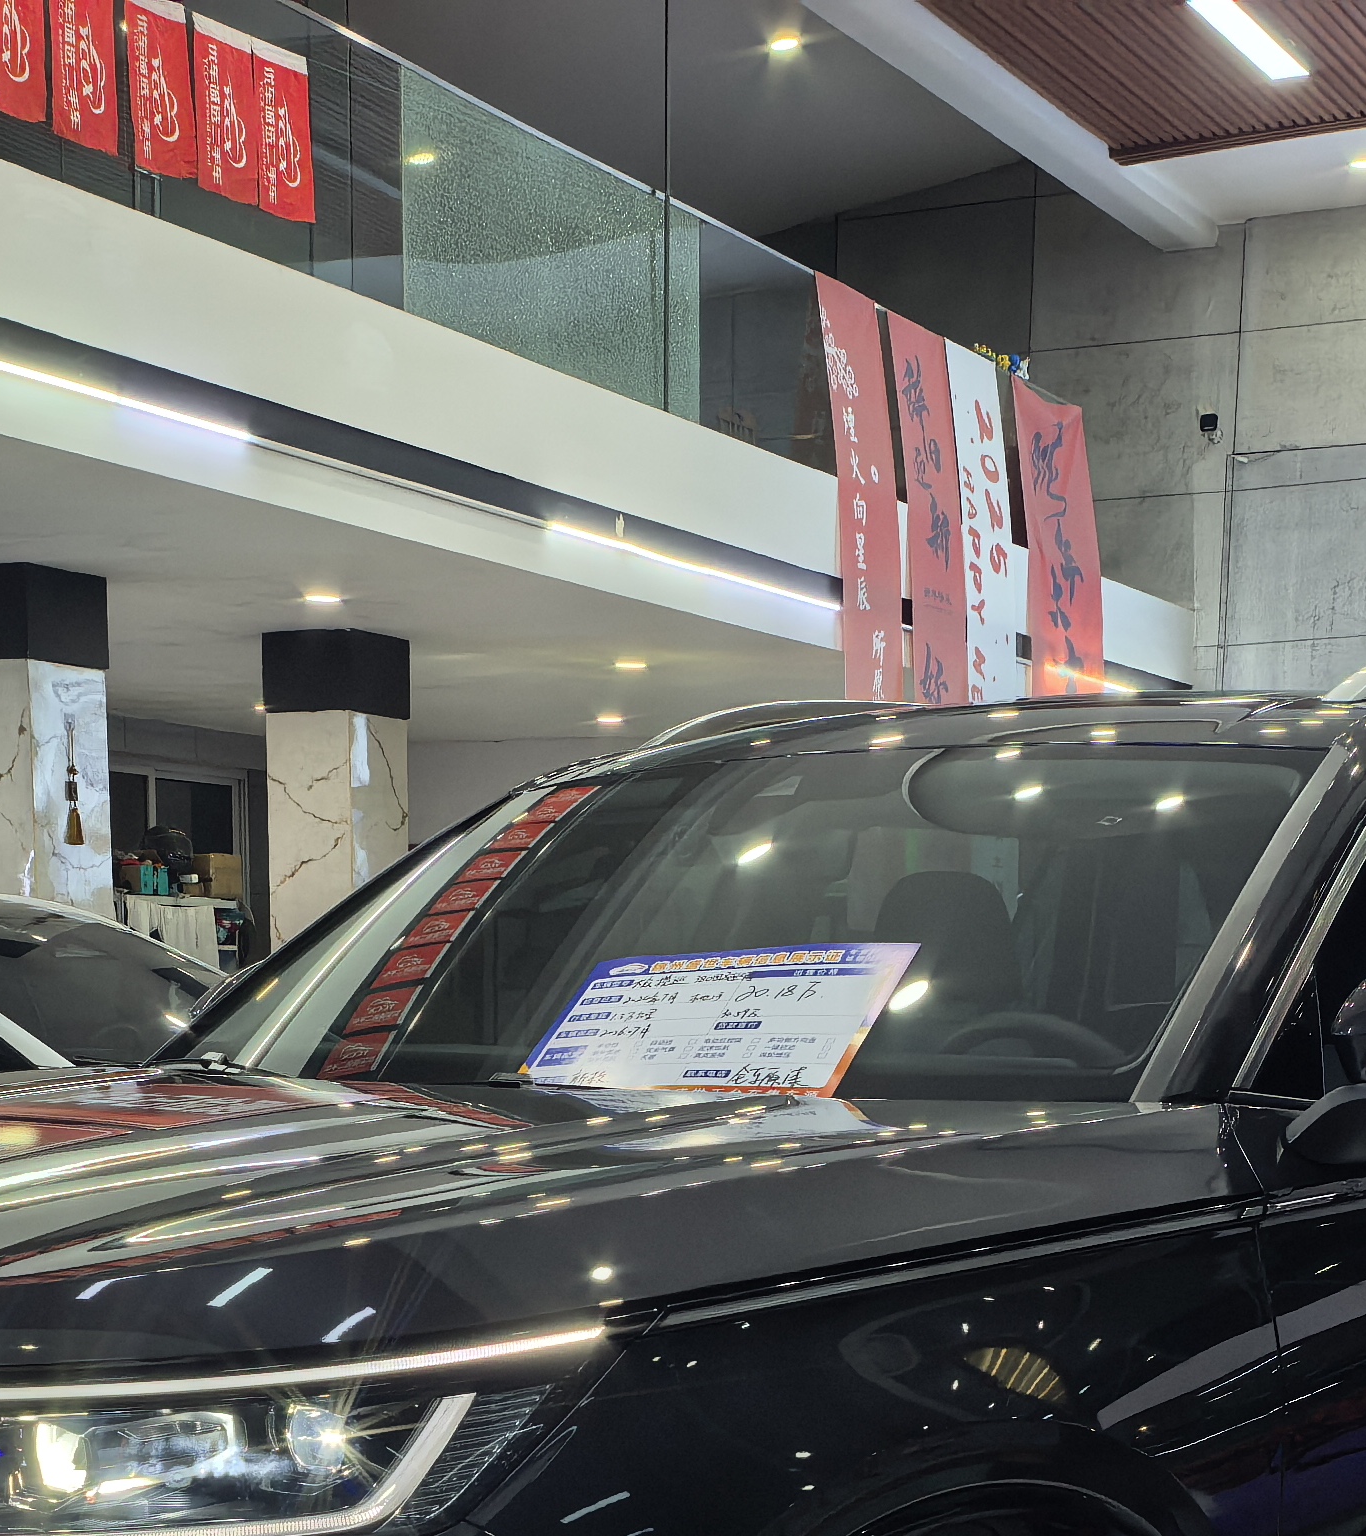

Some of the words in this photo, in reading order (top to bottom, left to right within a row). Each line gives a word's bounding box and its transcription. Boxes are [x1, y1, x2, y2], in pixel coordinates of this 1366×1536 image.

[62, 0, 82, 132] 车诚选二手车
[962, 466, 986, 626] HAPPY
[975, 399, 1009, 578] 2025
[970, 646, 986, 703] NE
